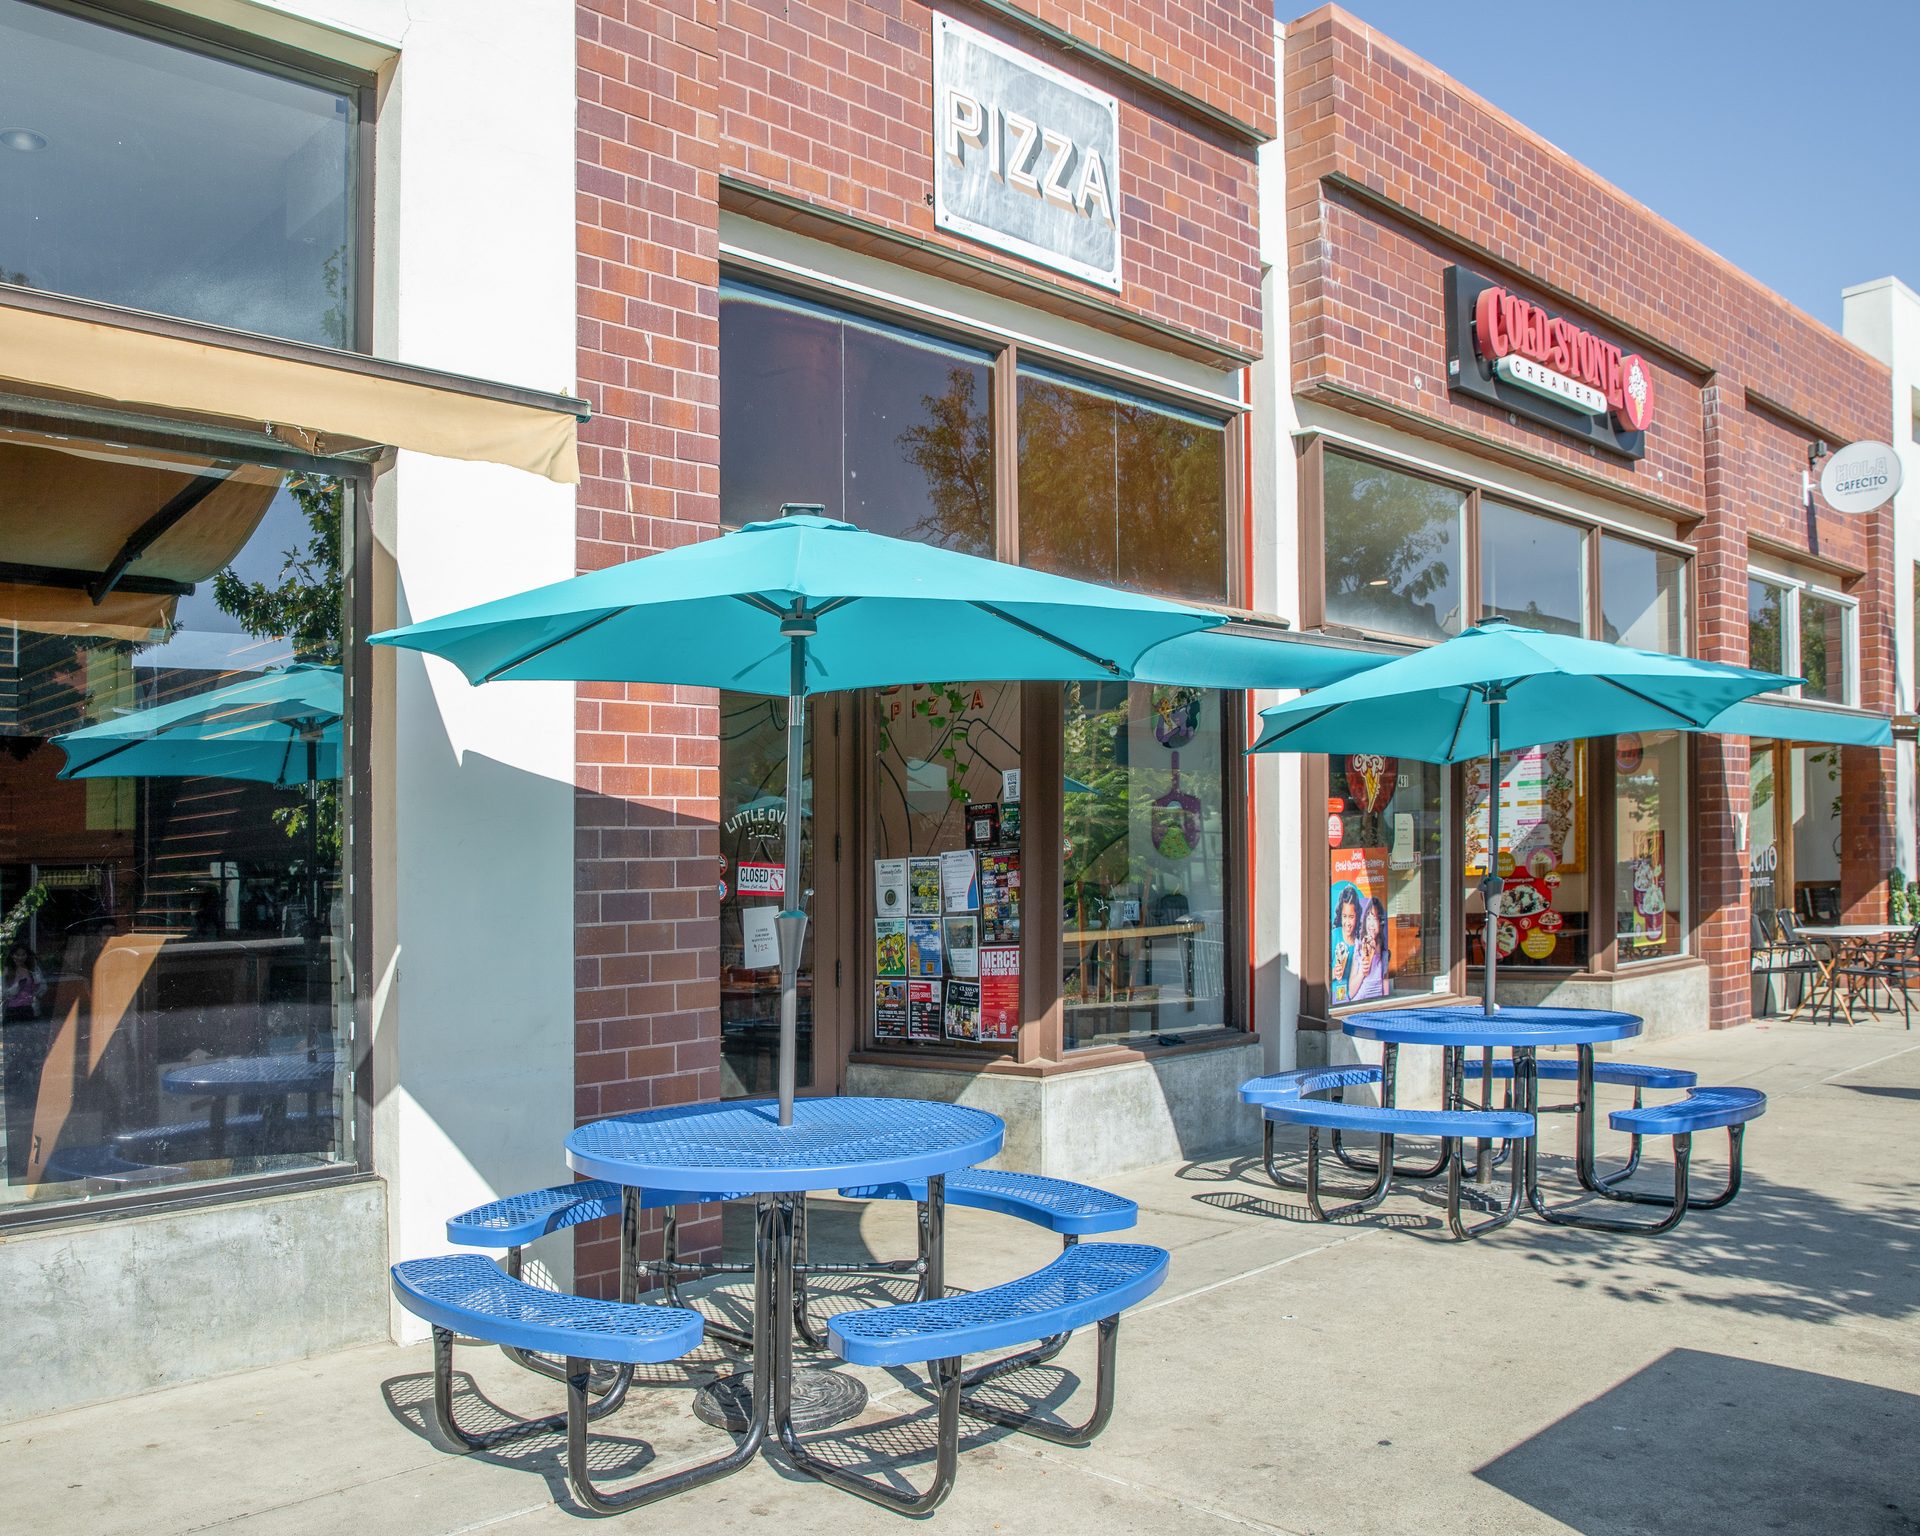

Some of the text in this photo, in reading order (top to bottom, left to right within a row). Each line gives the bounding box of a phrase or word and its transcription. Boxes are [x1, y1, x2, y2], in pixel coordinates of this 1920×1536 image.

[944, 88, 1116, 231] PIZZA
[1476, 286, 1624, 410] COLD STONE
[1514, 360, 1602, 408] CREAMERY
[1835, 456, 1889, 484] HOLA
[1835, 475, 1888, 492] CAFECITO
[890, 689, 984, 722] PIZA
[725, 808, 788, 834] LITTLE OV
[740, 868, 769, 883] CLOSED
[1335, 860, 1346, 872] Cold
[1347, 859, 1361, 871] Stone
